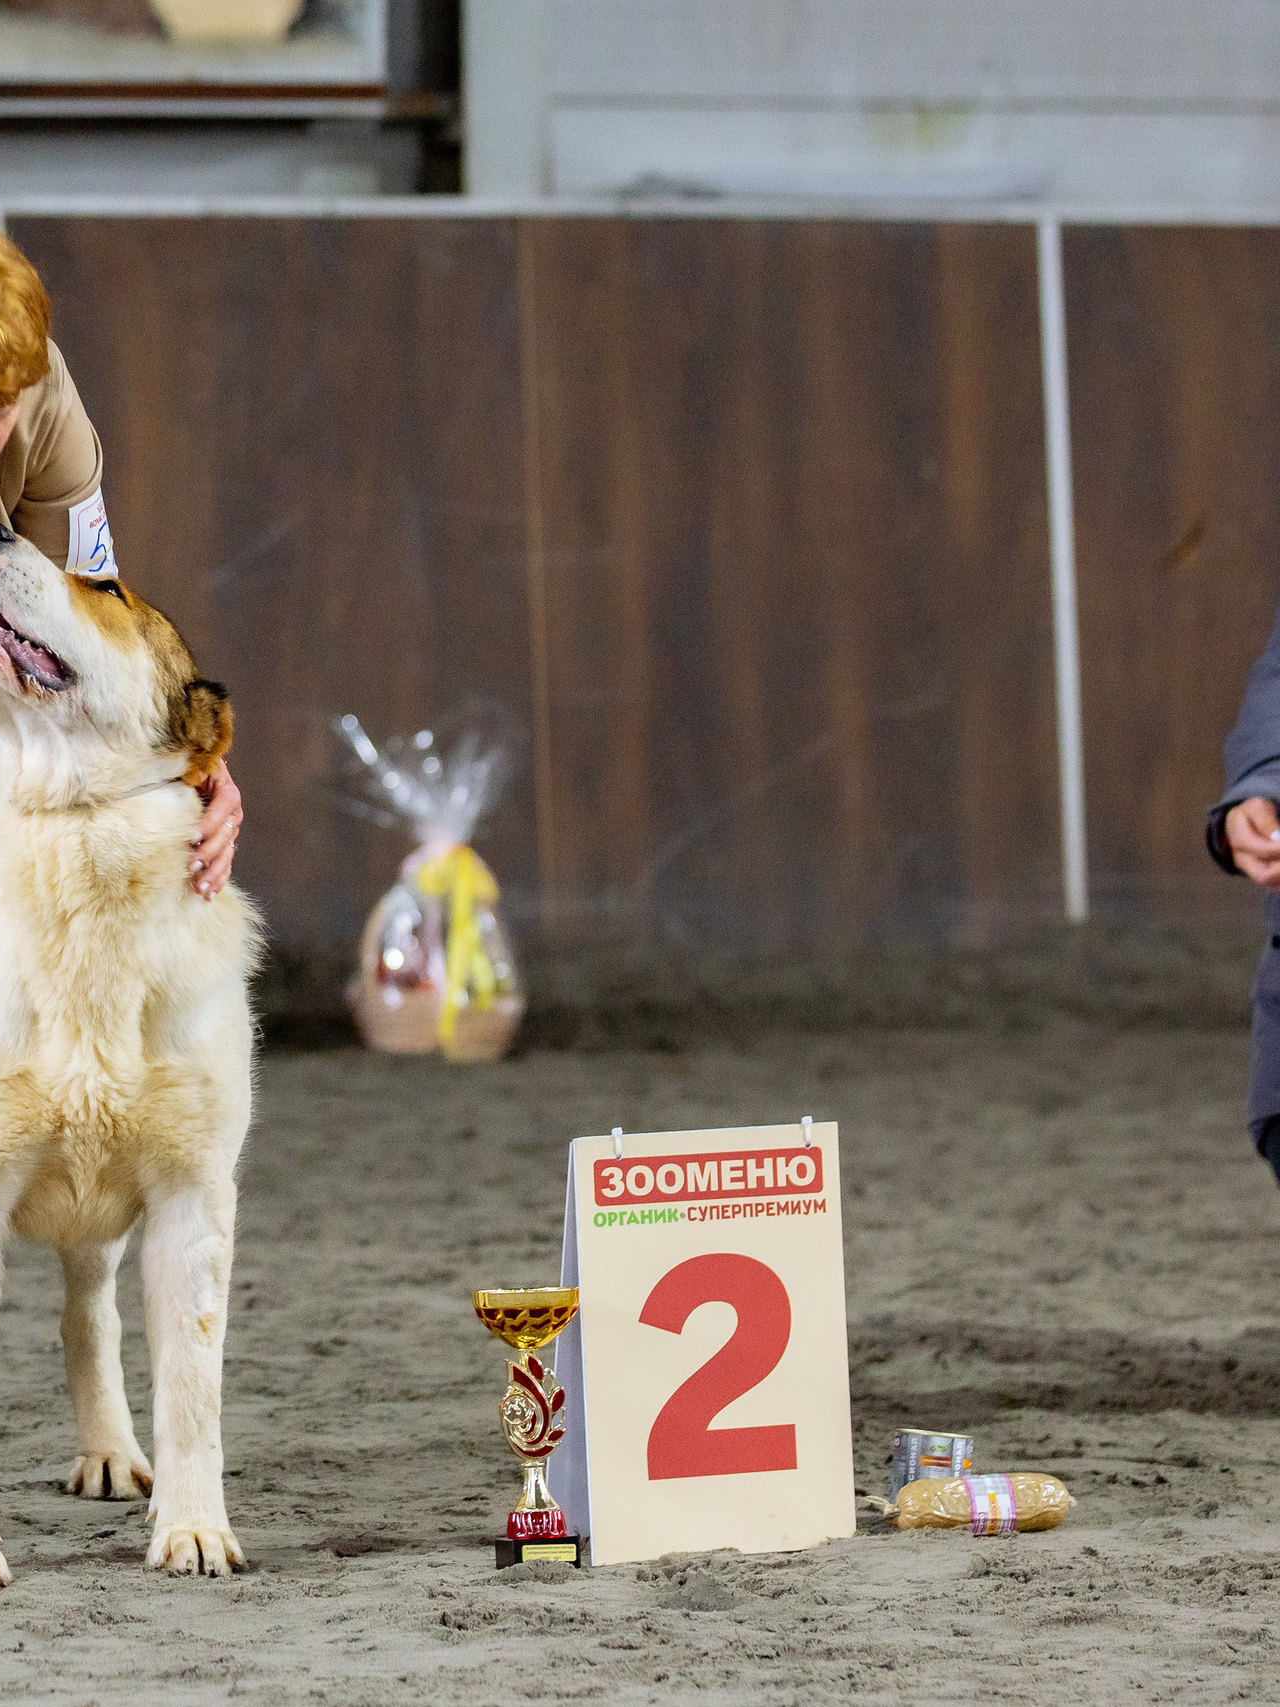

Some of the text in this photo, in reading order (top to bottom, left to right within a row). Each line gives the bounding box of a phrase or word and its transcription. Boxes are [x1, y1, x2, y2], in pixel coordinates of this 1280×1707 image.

[600, 1155, 816, 1198] ЗООМЕНЮ
[593, 1198, 827, 1228] ОРГАНИК СУПЕРПРЕМИУМ
[638, 1252, 798, 1481] 2
[909, 1437, 919, 1482] СИОНАЛ
